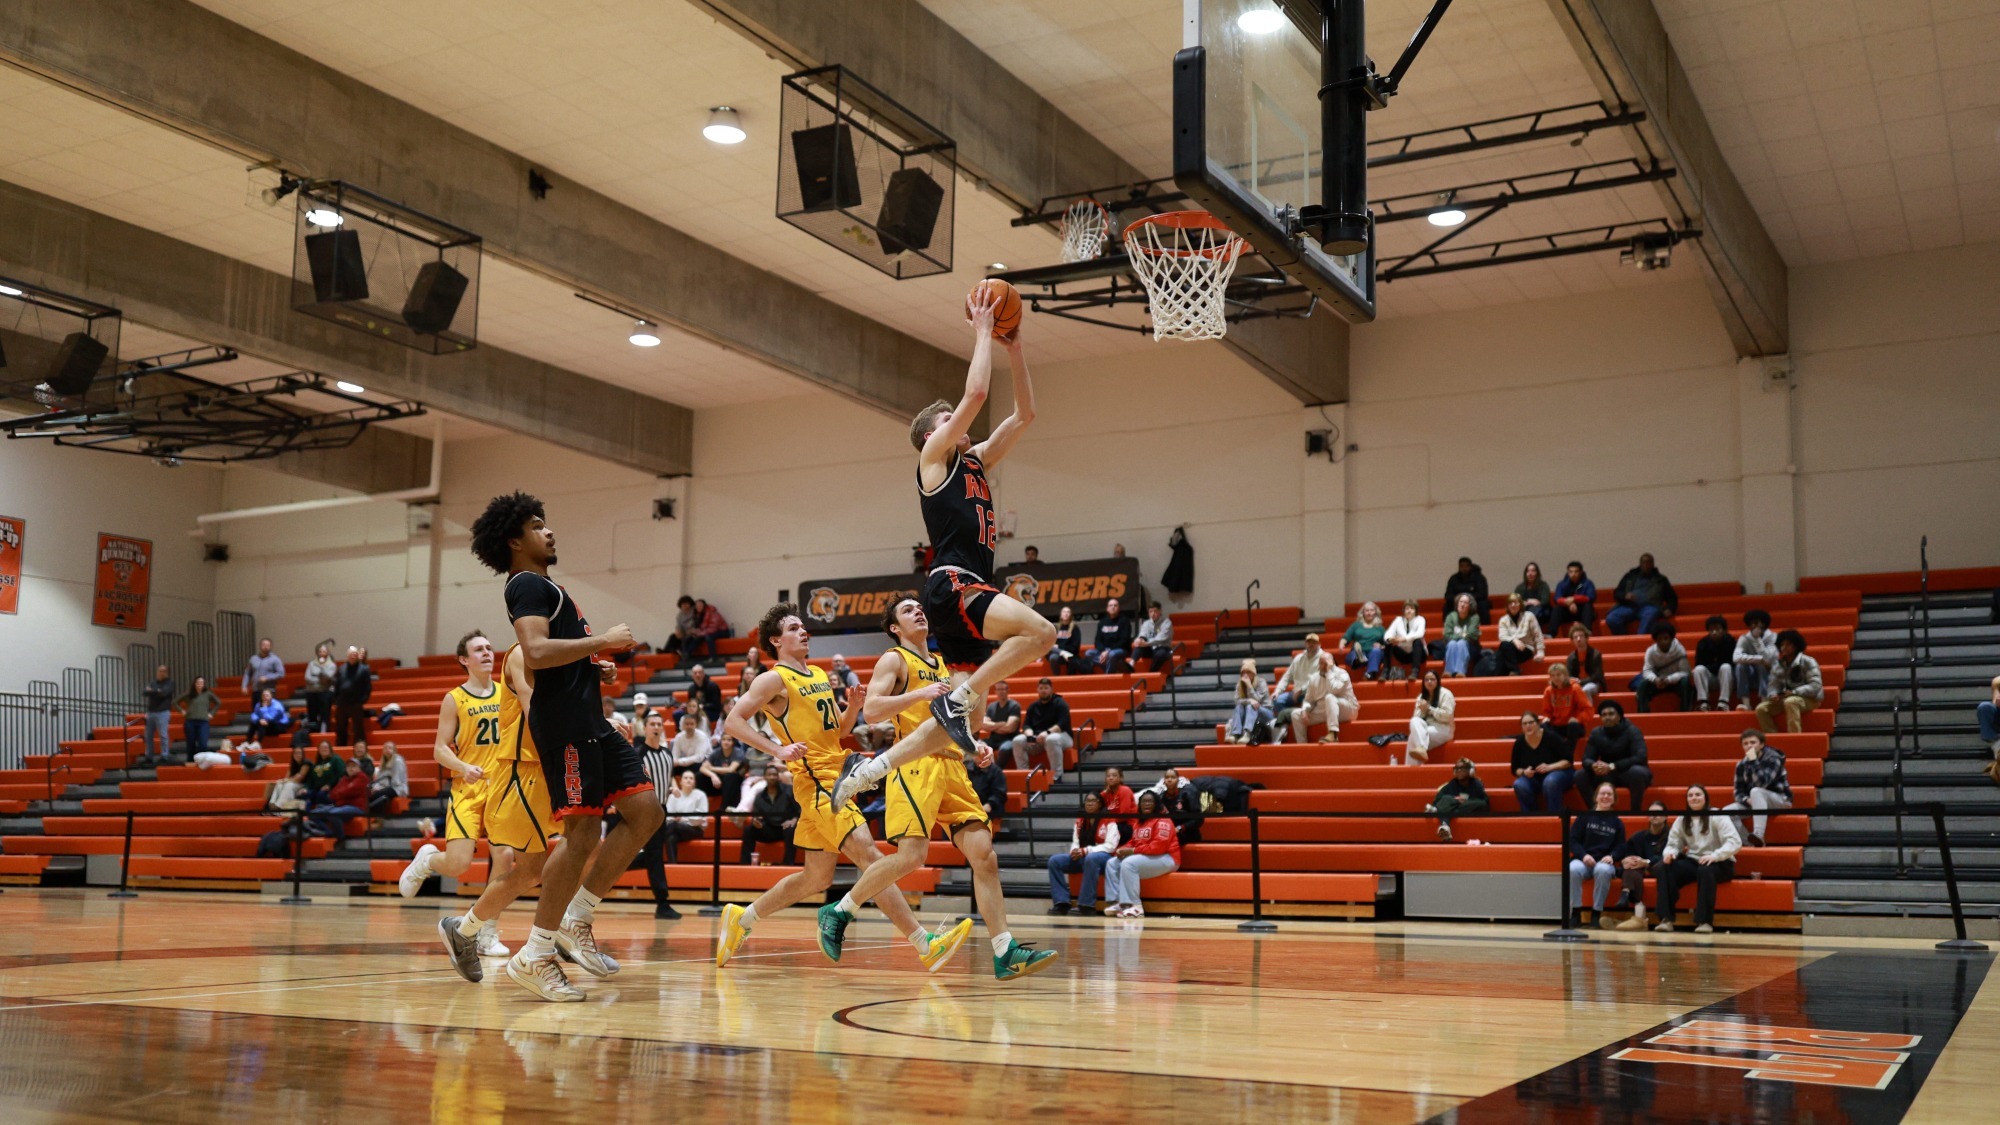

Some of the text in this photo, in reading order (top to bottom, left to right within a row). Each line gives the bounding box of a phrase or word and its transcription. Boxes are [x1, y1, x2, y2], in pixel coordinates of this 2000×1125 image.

[964, 472, 992, 501] RI
[976, 503, 996, 553] 12
[101, 549, 147, 569] RUNNER-UP
[107, 540, 142, 554] NATIONAL
[98, 590, 145, 604] LACROSSE
[836, 589, 919, 617] TIGE
[1036, 573, 1128, 604] TIGERS
[918, 669, 950, 685] CLAR
[468, 704, 500, 716] CLARKSO
[816, 698, 839, 730] 21
[476, 717, 501, 746] 20
[564, 744, 582, 804] GERS
[1608, 1020, 1923, 1090] RIT
